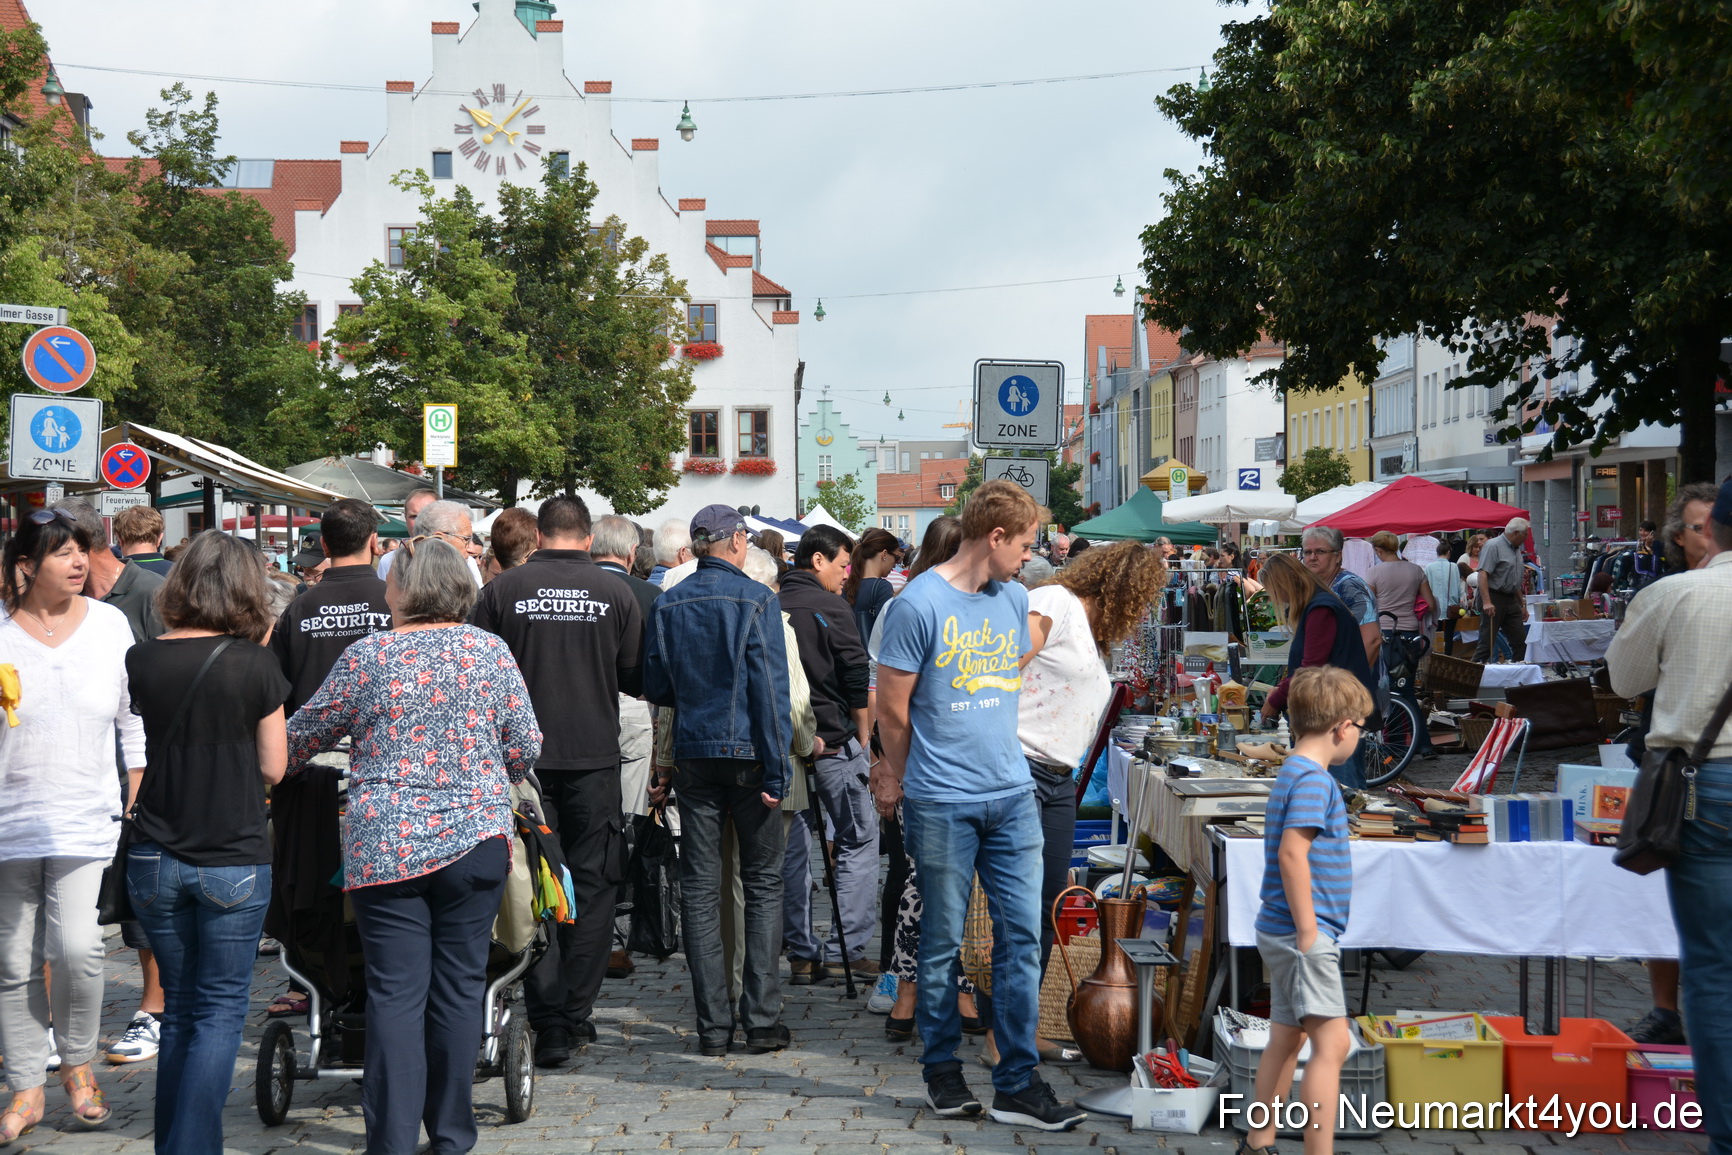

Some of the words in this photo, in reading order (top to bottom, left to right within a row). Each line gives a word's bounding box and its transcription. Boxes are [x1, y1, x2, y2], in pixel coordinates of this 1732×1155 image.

[26, 309, 54, 321] Gasse
[435, 414, 446, 427] H
[998, 424, 1038, 437] ZONE
[1175, 472, 1183, 480] H
[106, 496, 146, 504] Feuerwehr-
[537, 588, 589, 599] CONSEC
[320, 602, 369, 615] CONSEC
[515, 598, 610, 616] SECURITY
[300, 612, 391, 632] SECURITY
[528, 613, 597, 622] www.consec.de
[311, 626, 379, 638] www.consec.de
[935, 615, 1007, 668] Jack
[951, 648, 1019, 689] Jones
[978, 697, 1000, 709] 1975
